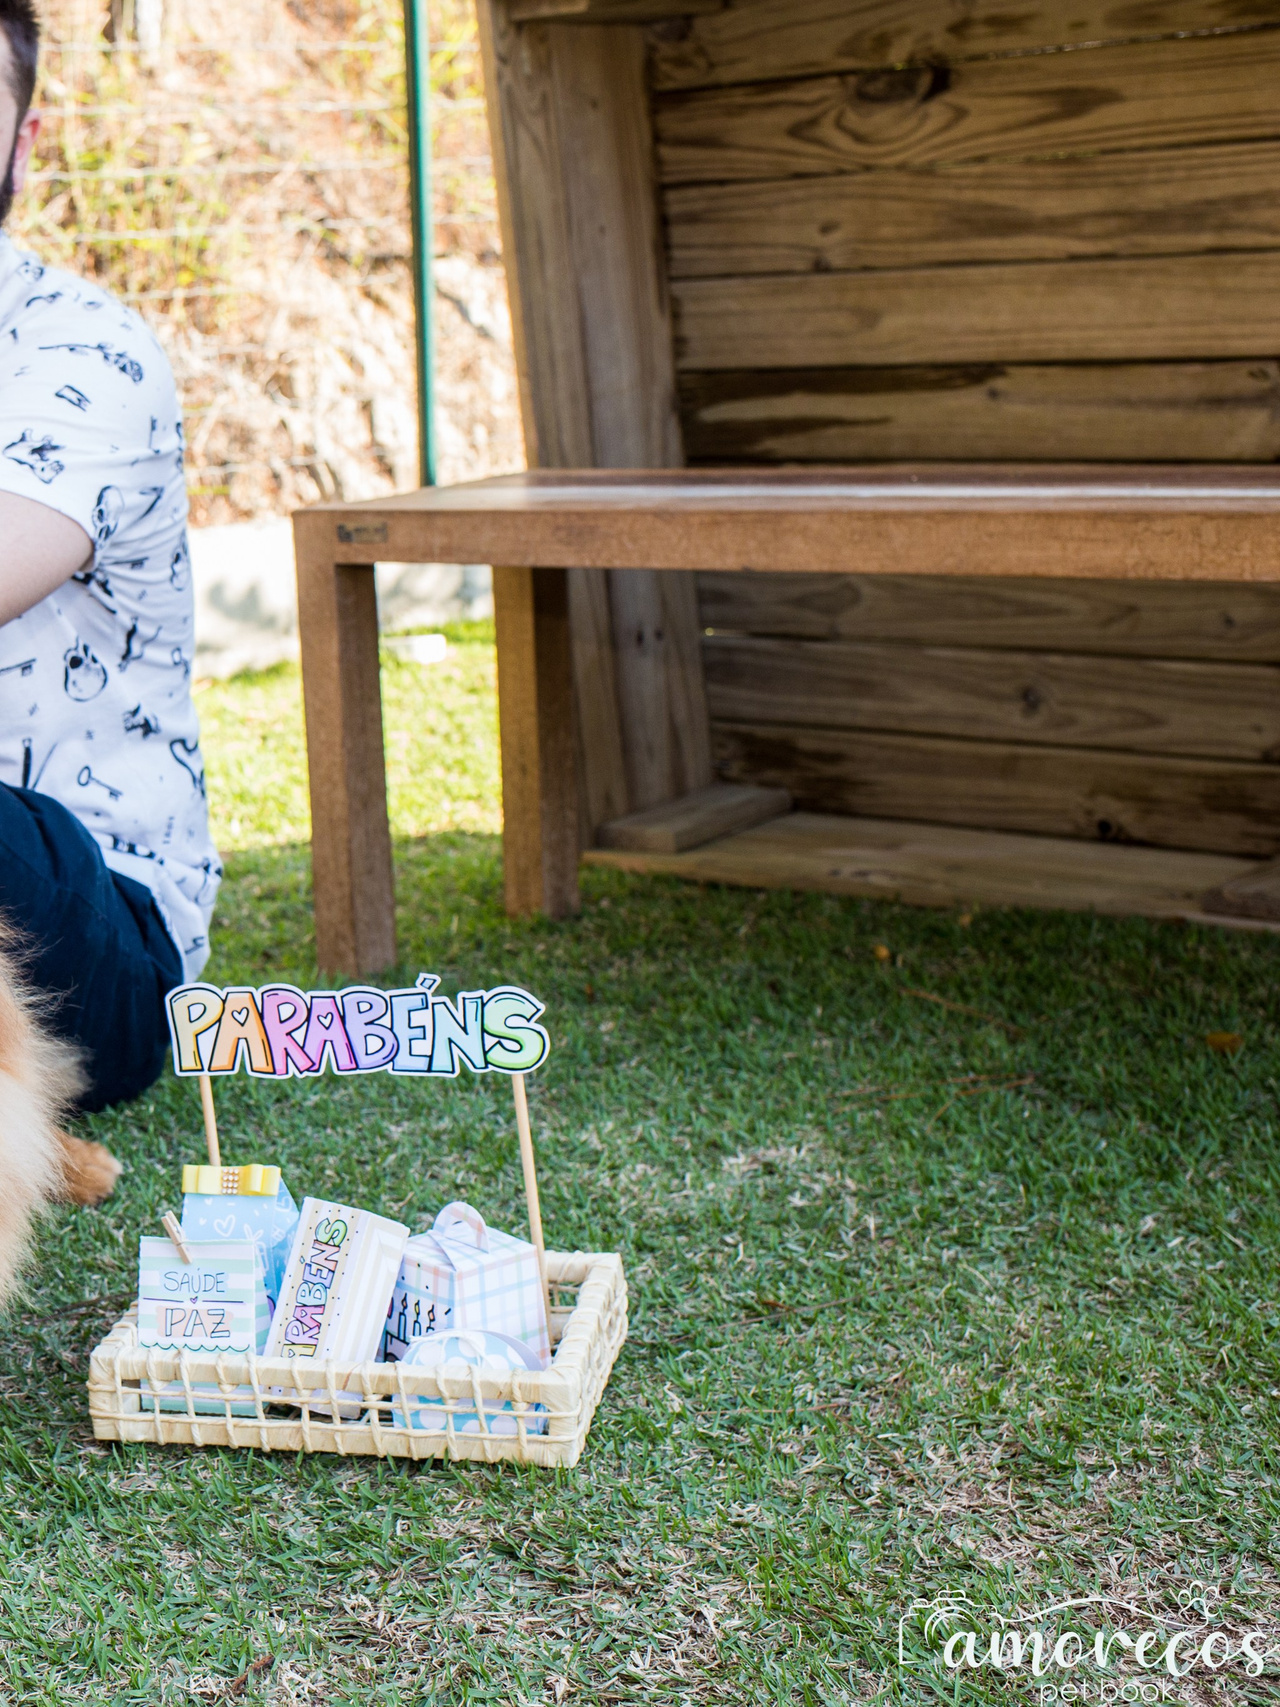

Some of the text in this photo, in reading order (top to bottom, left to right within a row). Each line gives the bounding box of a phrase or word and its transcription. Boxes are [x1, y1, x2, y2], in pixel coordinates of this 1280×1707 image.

[168, 975, 546, 1076] PARABÉNS
[163, 1267, 226, 1294] SAÚDE
[280, 1217, 348, 1358] ARABÉNS
[164, 1308, 231, 1338] PAZ
